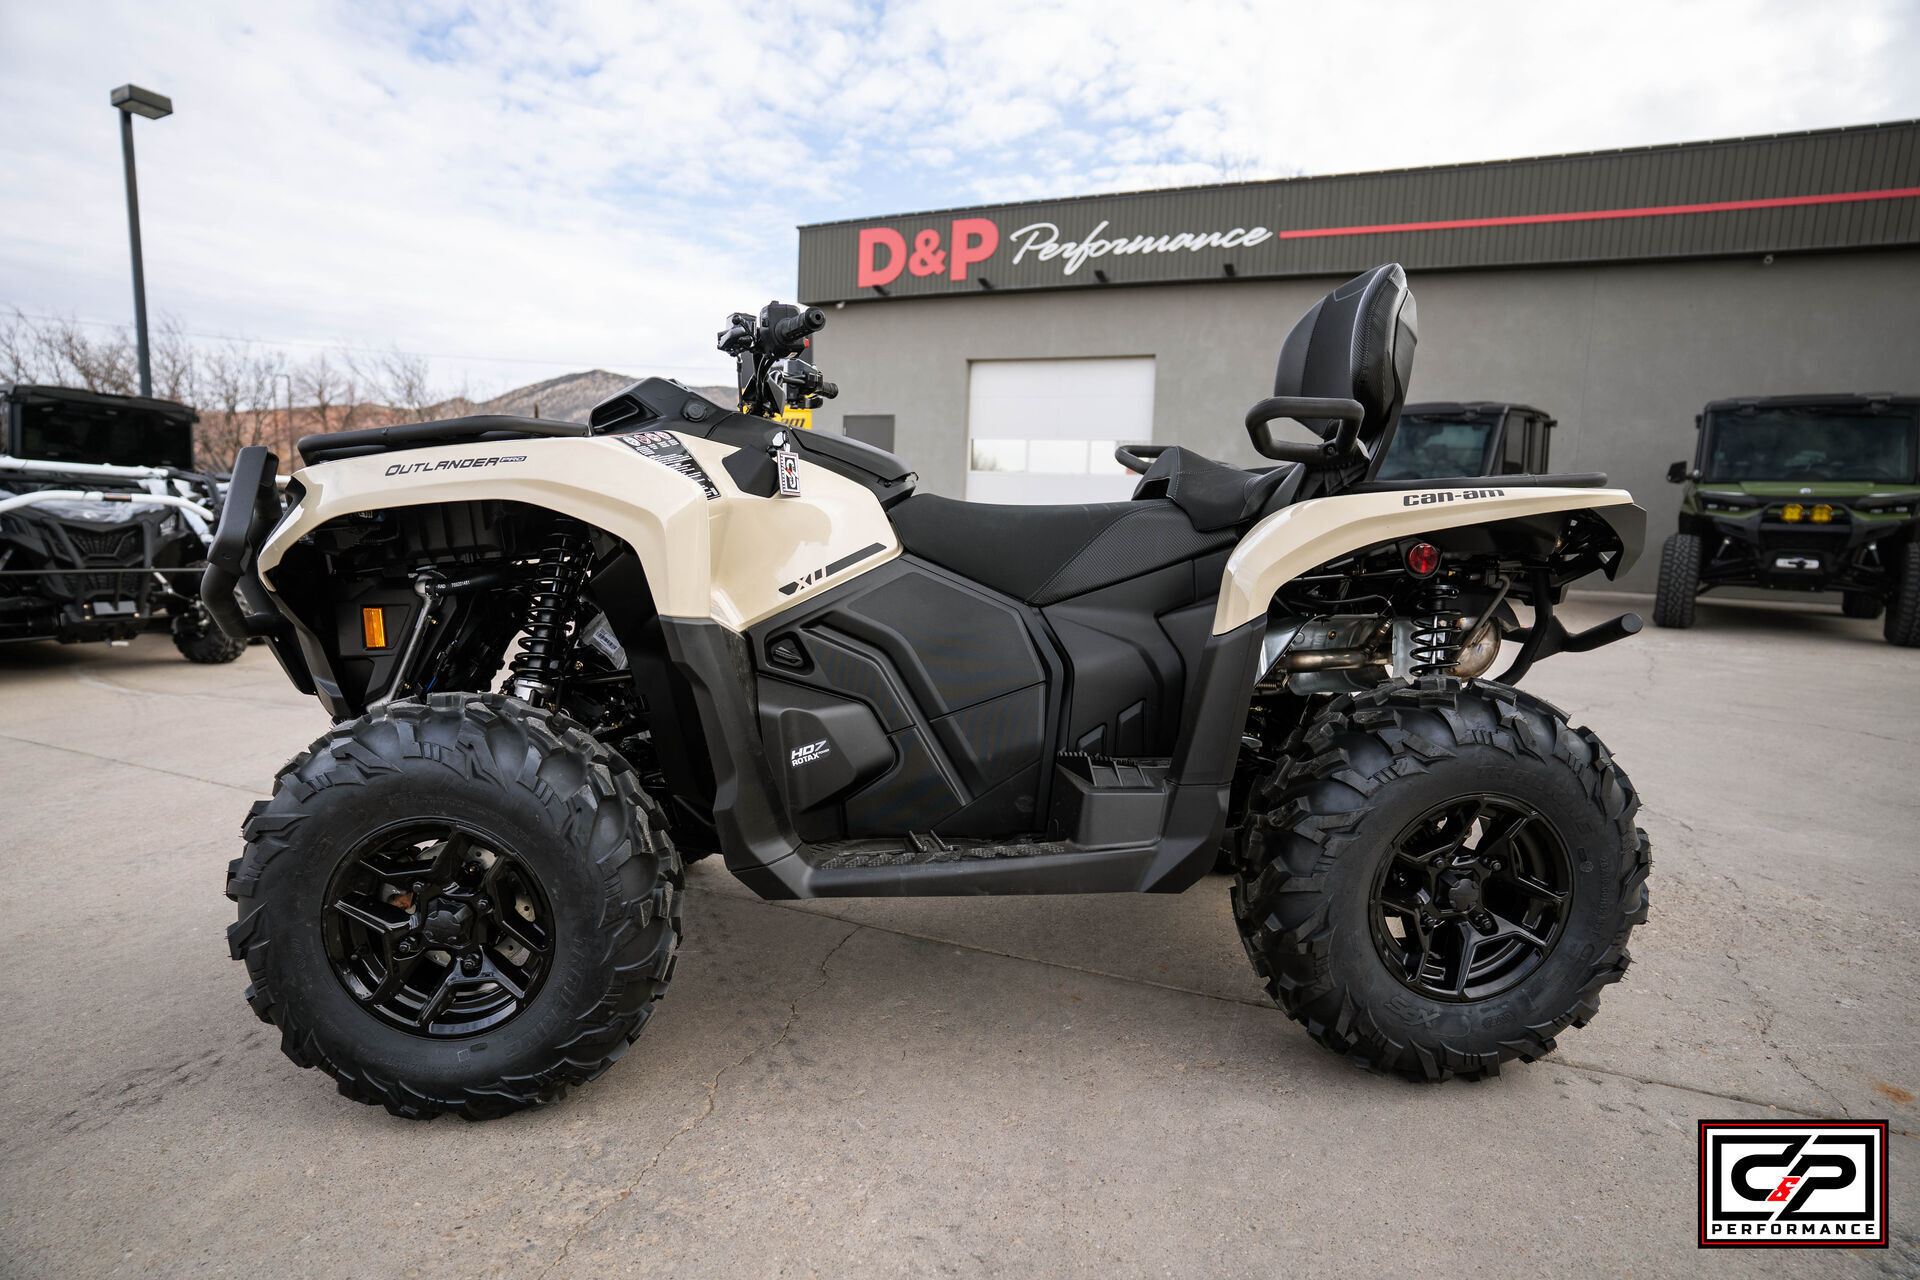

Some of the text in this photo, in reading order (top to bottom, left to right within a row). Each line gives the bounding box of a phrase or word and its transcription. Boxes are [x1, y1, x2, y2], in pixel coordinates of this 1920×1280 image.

[857, 217, 1273, 288] D&P Performance
[385, 457, 499, 476] OUTLANDER
[1403, 489, 1505, 507] can-am
[791, 740, 827, 760] HD7
[792, 752, 820, 767] ROTAX
